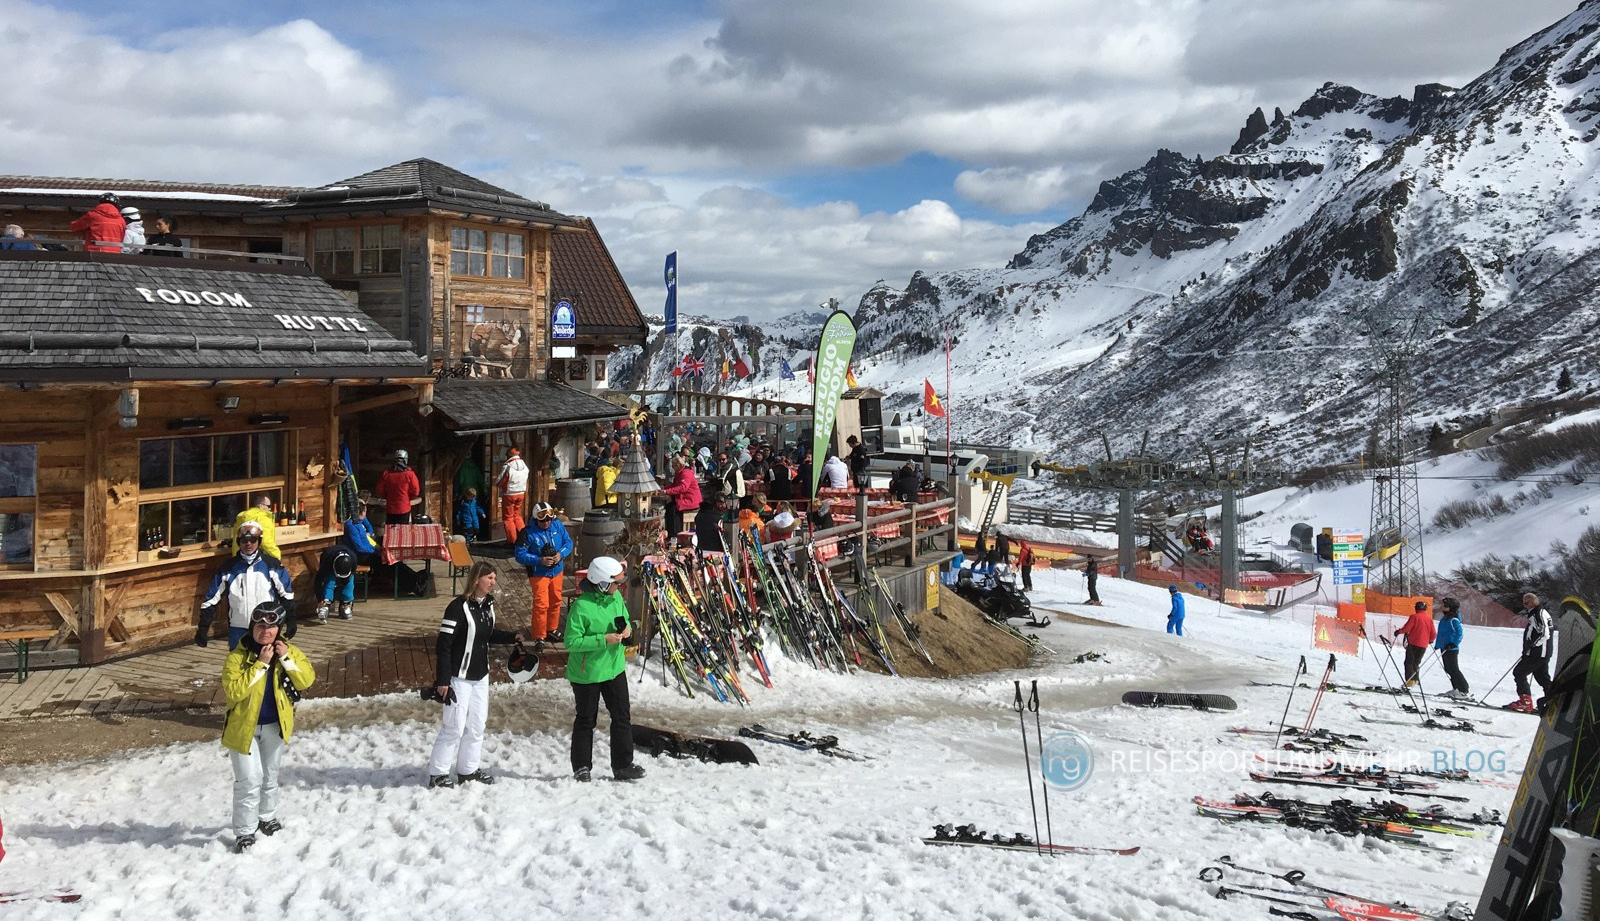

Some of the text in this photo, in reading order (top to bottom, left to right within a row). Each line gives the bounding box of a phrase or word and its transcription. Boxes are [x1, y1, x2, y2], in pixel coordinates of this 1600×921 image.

[135, 287, 253, 308] FODOM
[274, 314, 368, 332] HUTTE
[816, 344, 837, 439] RIFUGIO
[824, 356, 847, 437] FODOM
